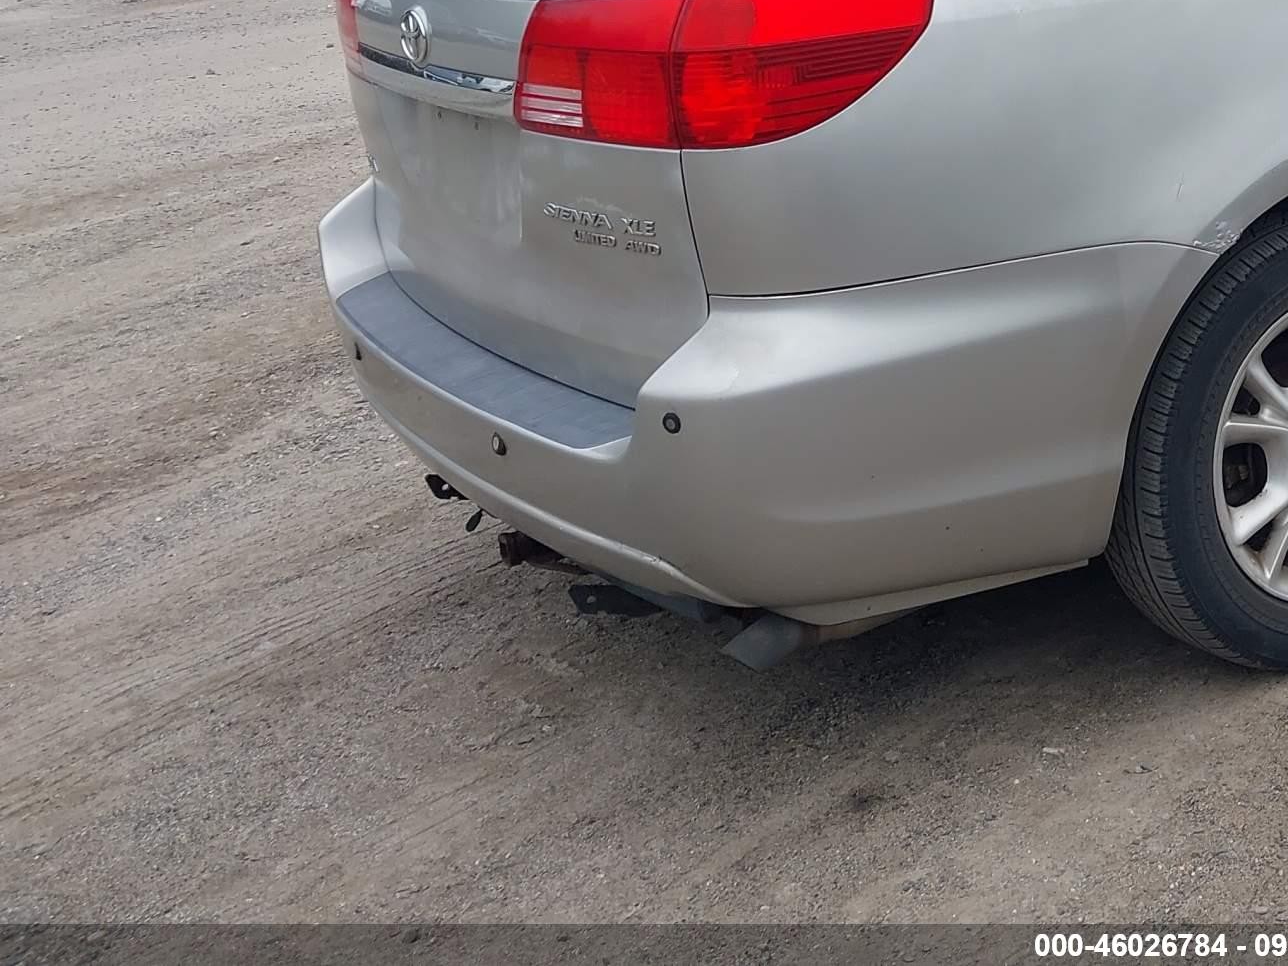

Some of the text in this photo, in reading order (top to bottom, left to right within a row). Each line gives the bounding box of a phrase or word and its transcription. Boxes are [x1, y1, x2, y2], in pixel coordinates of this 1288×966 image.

[543, 202, 656, 237] SIENNA XLE
[573, 229, 662, 256] LIMITED AWD
